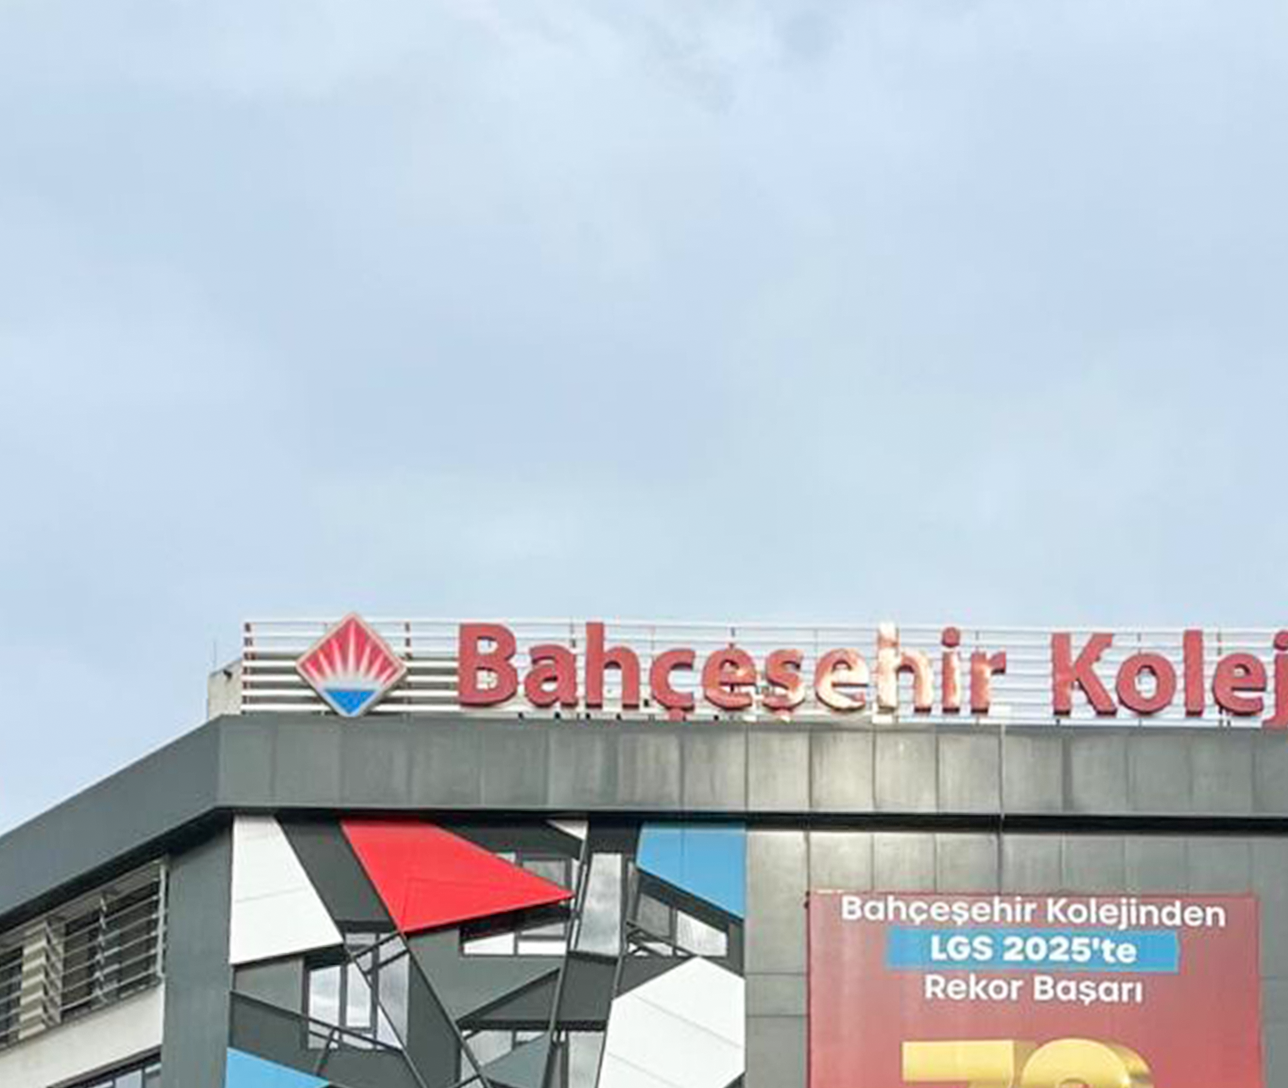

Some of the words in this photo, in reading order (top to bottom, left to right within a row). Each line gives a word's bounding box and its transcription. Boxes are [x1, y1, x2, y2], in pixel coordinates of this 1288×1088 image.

[458, 622, 1005, 722] Bahçeşehir
[841, 895, 1037, 926] Bahçeşehir
[1047, 897, 1226, 929] Kolejinden
[931, 935, 993, 962] LGS
[1003, 936, 1138, 964] 2025'te
[924, 974, 1025, 1001] Rekor
[1034, 976, 1143, 1006] Başarı
